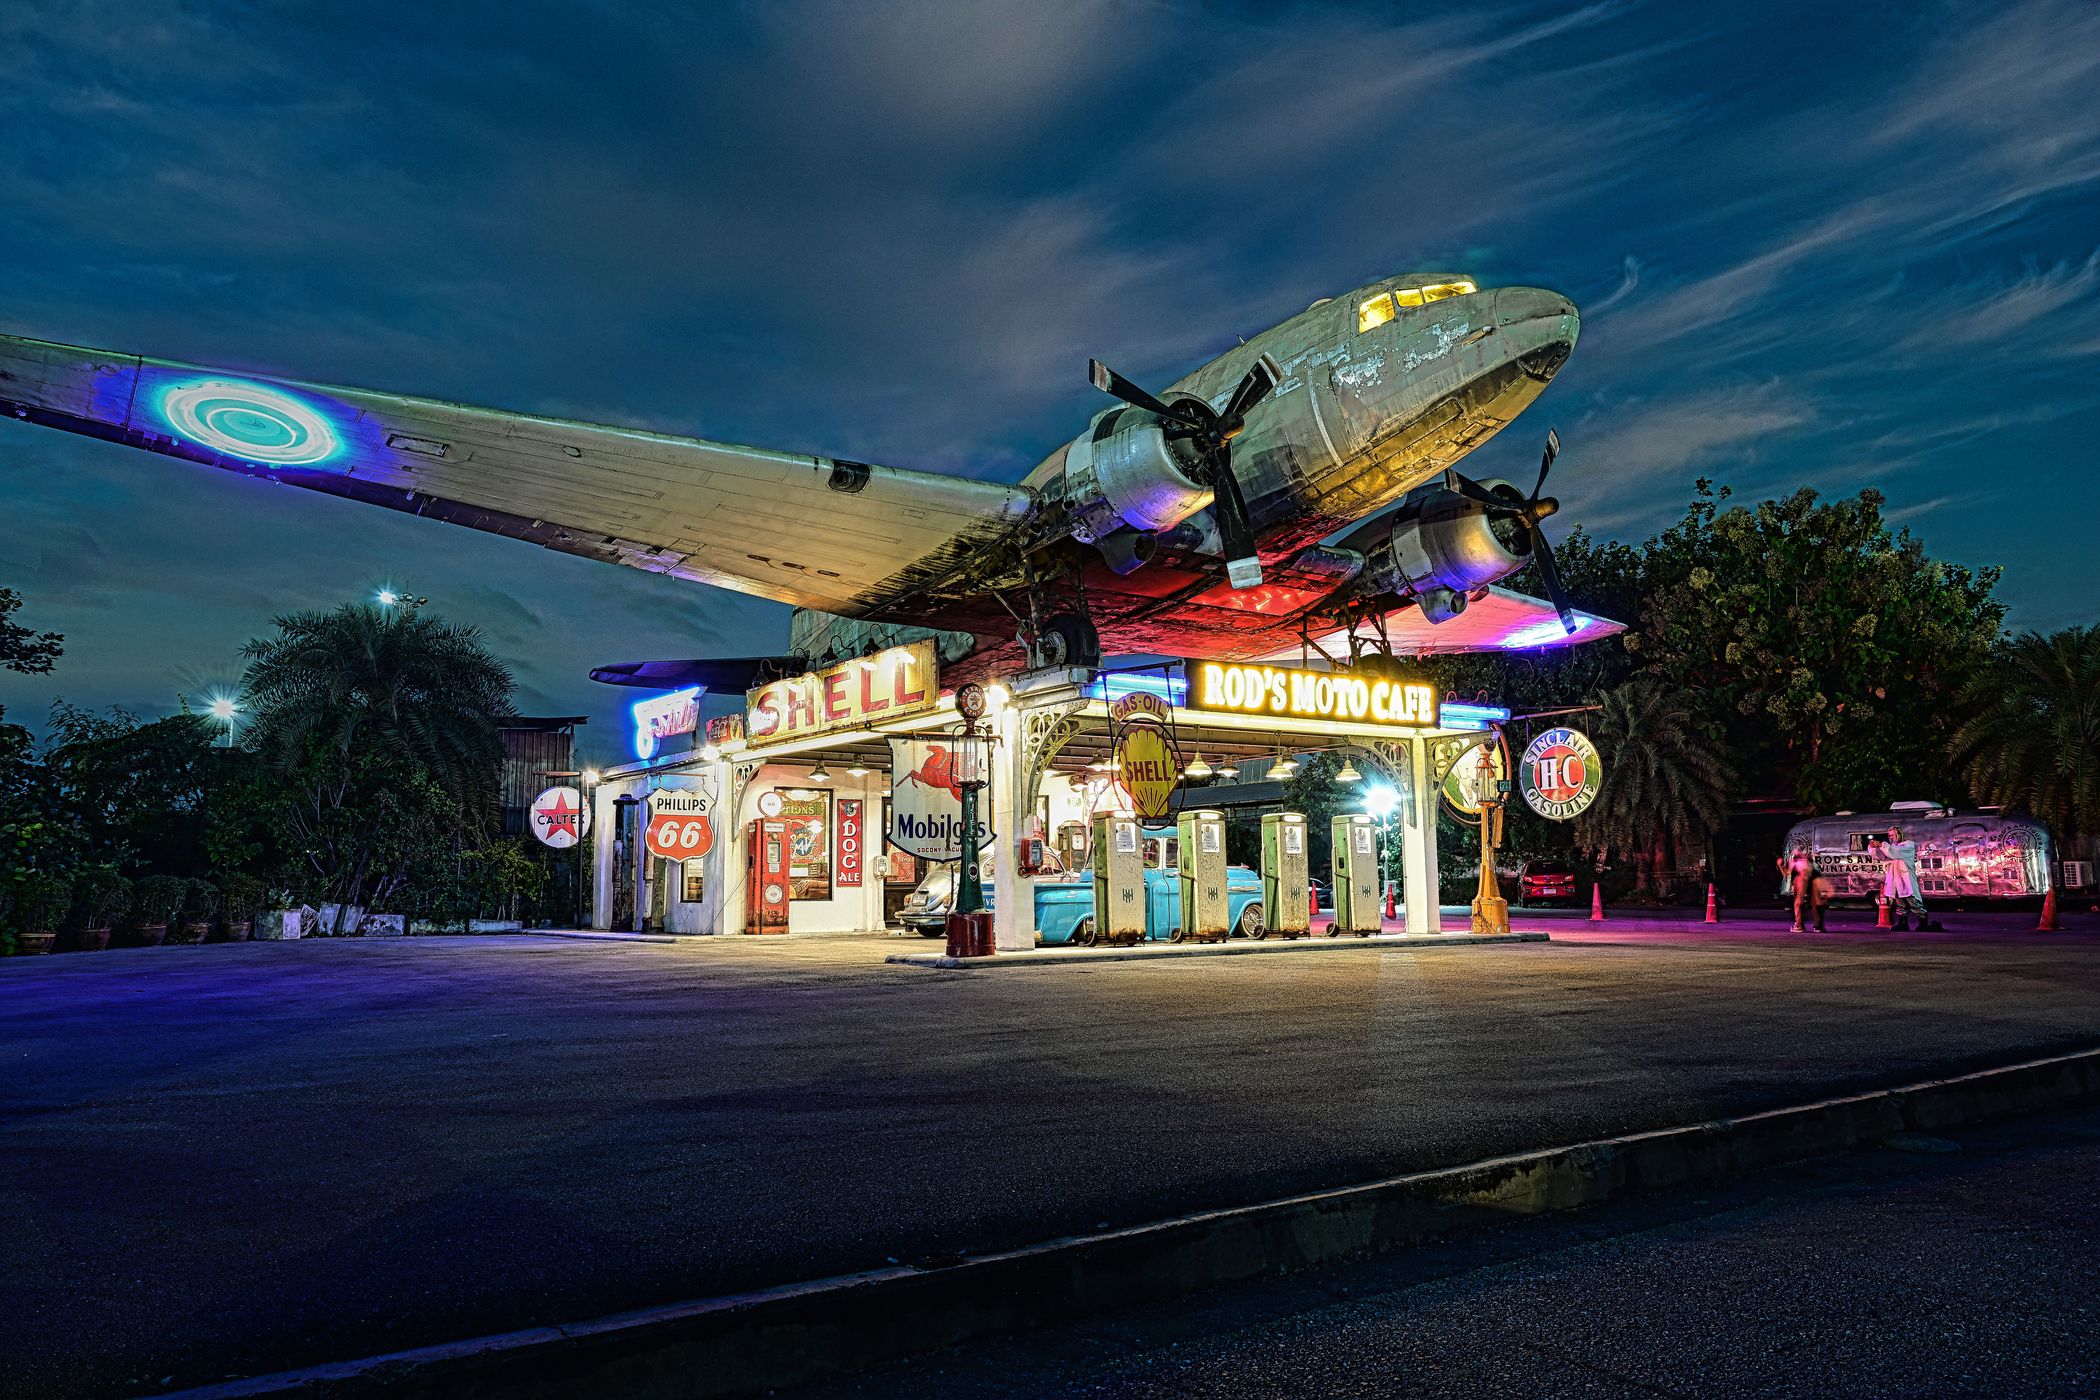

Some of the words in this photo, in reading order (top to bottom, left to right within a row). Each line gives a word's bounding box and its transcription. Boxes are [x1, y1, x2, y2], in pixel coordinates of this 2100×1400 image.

[756, 657, 926, 737] SHELL
[1204, 664, 1287, 711] ROD'S
[1290, 673, 1369, 717] MOTO
[1371, 681, 1433, 722] CAFE
[1524, 731, 1594, 766] SINCLAIR
[1126, 760, 1172, 782] SHELL
[657, 797, 707, 812] PHILLIPS
[1527, 783, 1596, 816] GASOLINE
[657, 820, 703, 849] 66
[842, 820, 857, 869] DOG
[898, 813, 986, 845] Mobilgs
[838, 872, 860, 882] ALE
